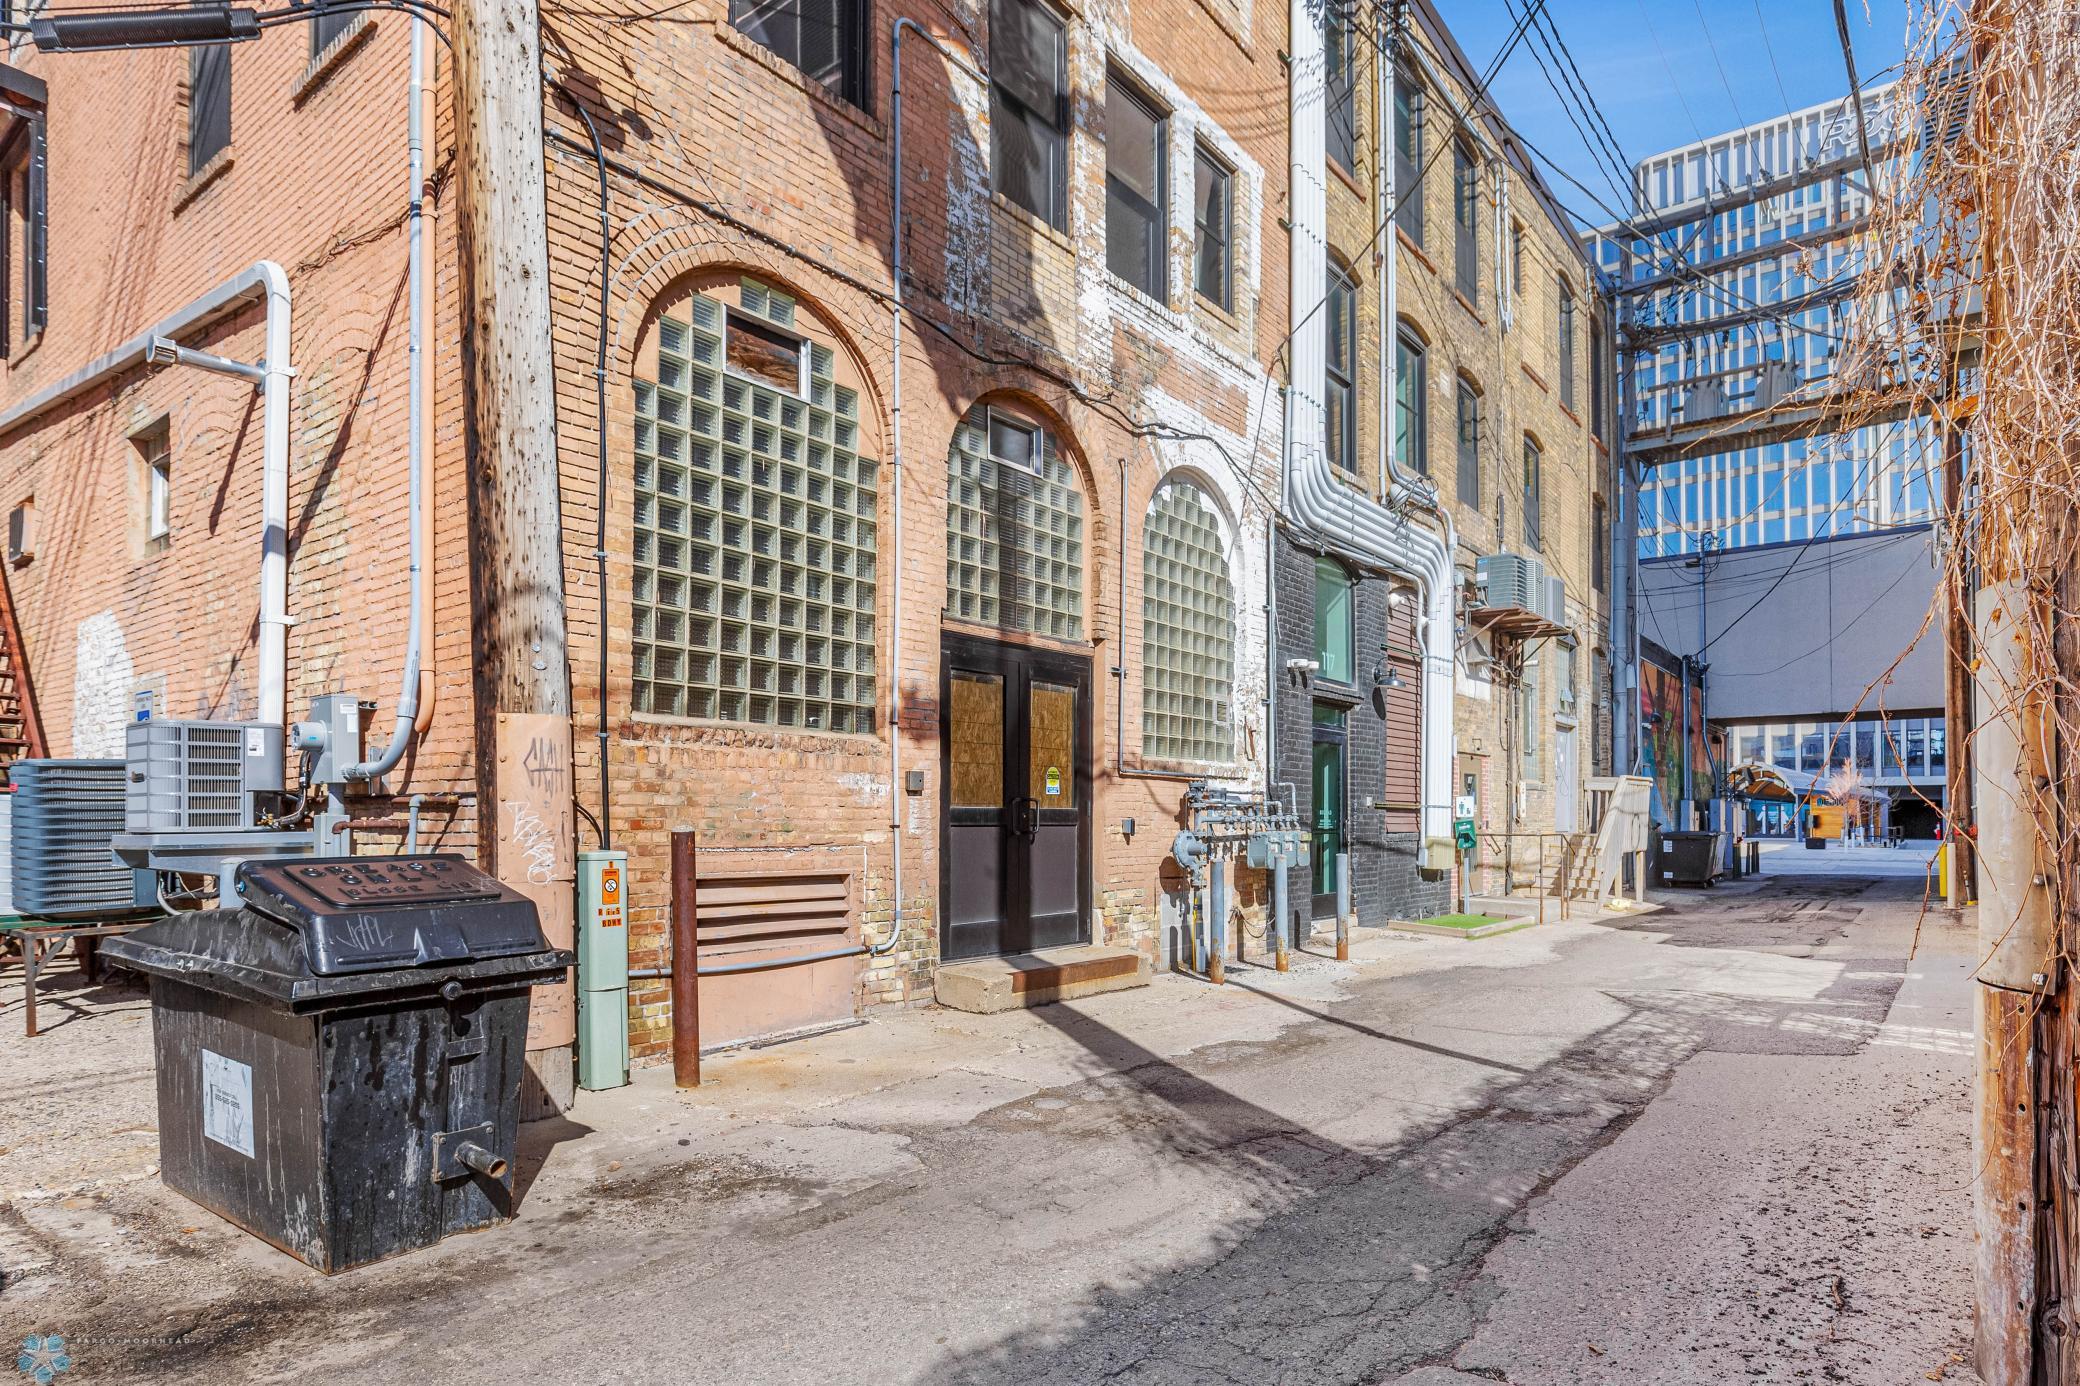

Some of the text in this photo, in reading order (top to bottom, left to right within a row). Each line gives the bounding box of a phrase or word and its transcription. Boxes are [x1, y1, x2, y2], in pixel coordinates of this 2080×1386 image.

[1321, 651, 1336, 672] 117
[300, 861, 452, 878] GREASE
[340, 871, 440, 885] ONLY
